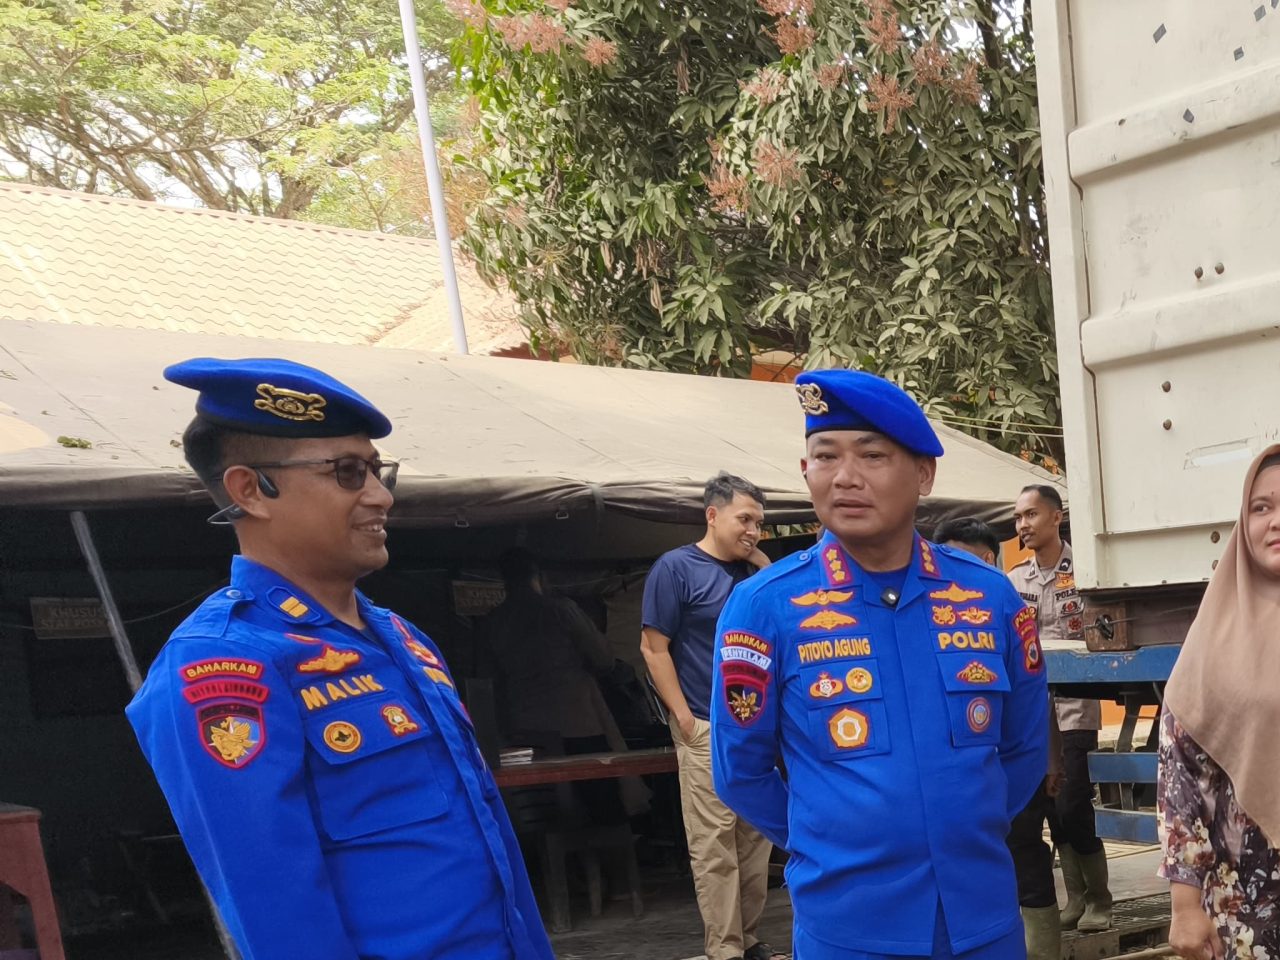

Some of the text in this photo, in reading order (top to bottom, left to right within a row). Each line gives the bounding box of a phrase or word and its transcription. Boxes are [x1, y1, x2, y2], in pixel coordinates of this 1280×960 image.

[724, 633, 768, 653] BAHARKAM
[937, 631, 995, 650] POLRI
[723, 649, 769, 667] PENYELAM
[798, 638, 870, 664] PITOYO AGUNG
[186, 661, 257, 678] BAHARKAM
[300, 674, 384, 710] MALIK
